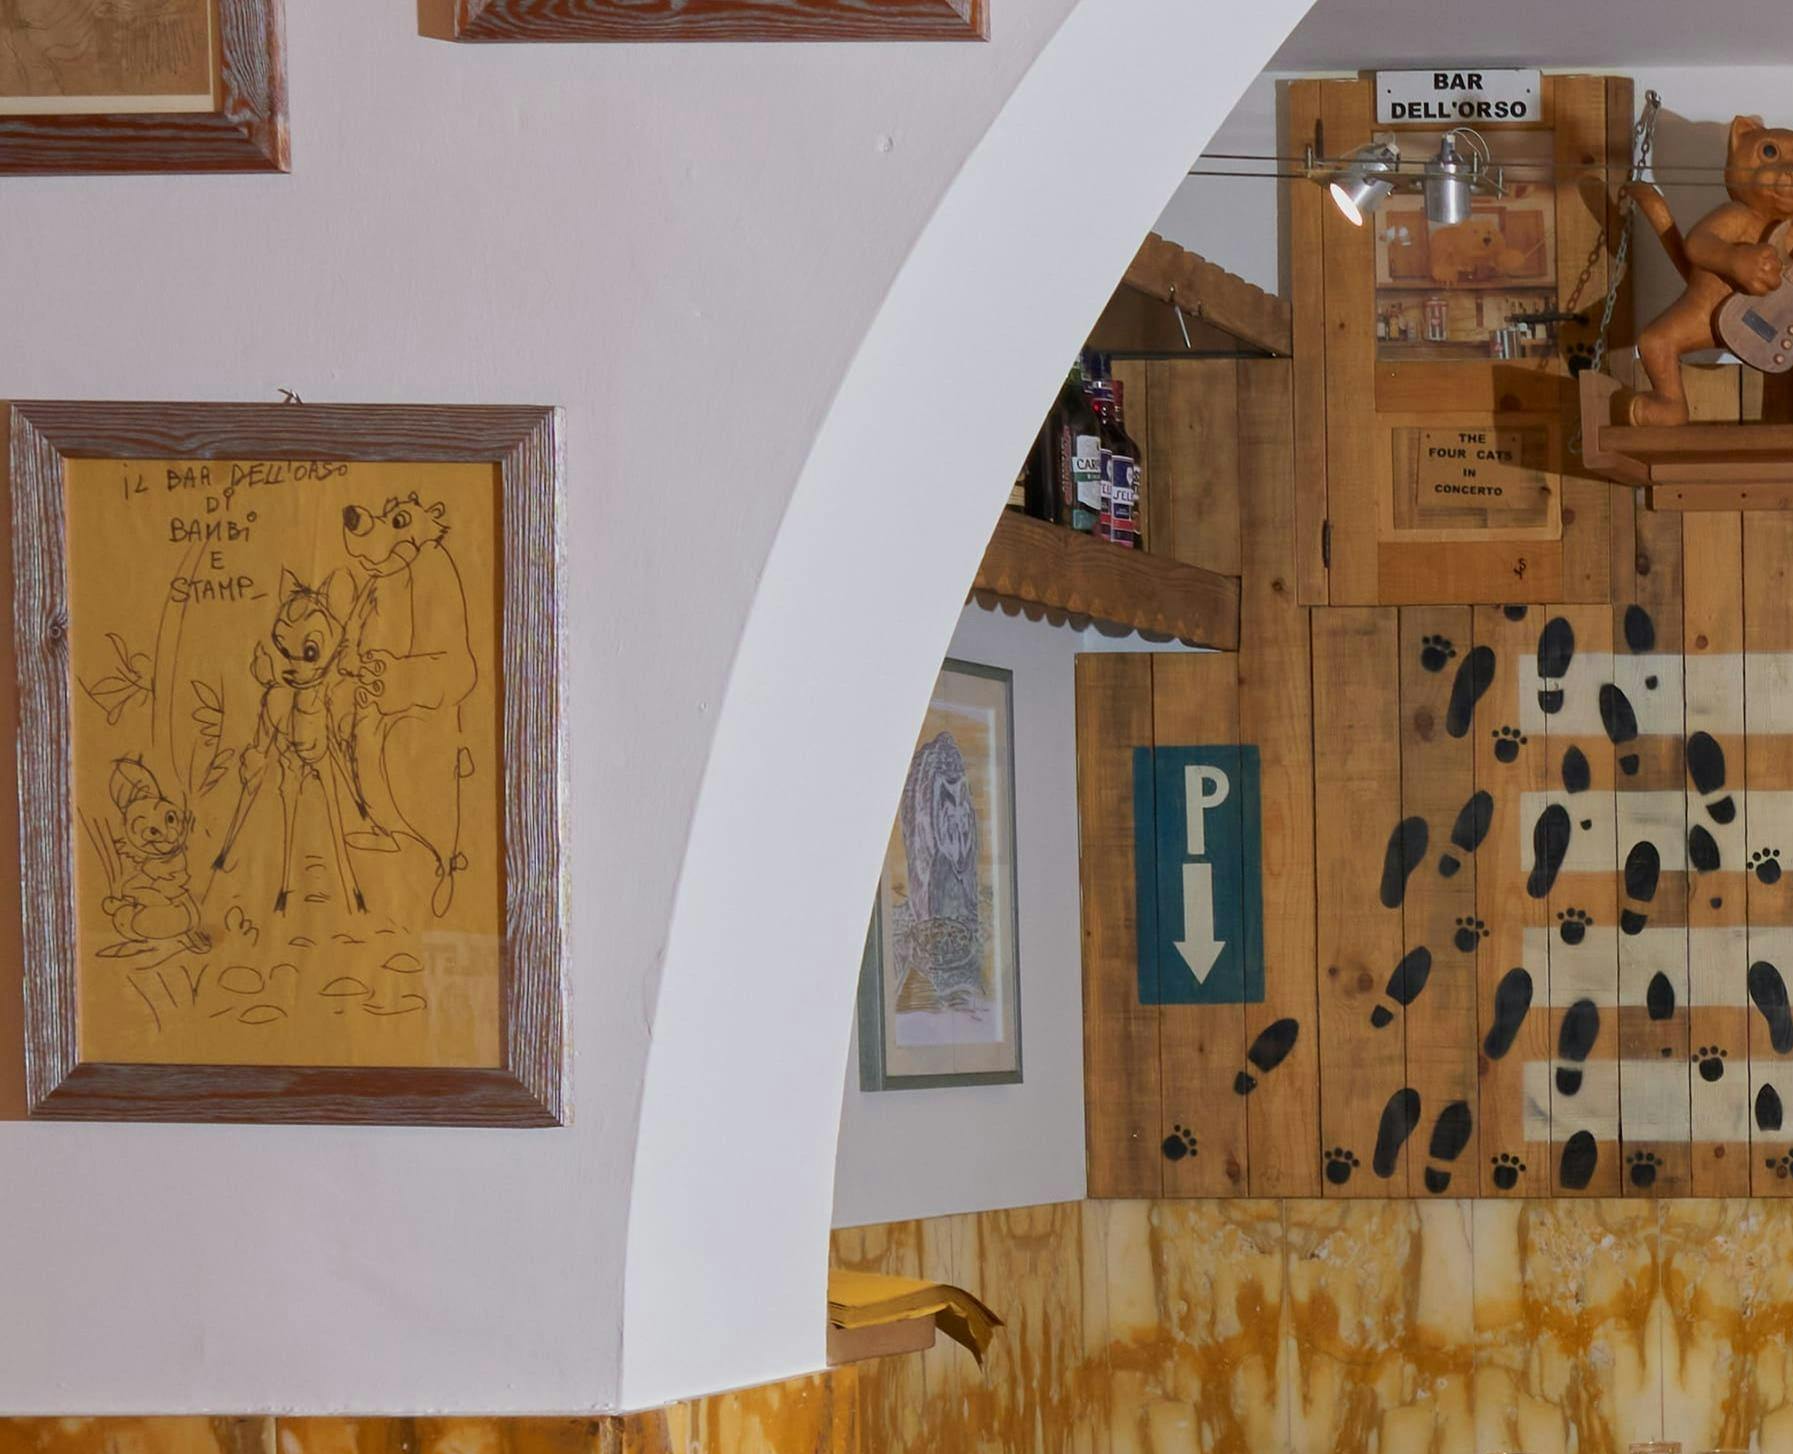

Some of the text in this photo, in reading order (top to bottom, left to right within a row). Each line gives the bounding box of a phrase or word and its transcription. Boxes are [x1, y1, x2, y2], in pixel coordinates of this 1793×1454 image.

[1433, 73, 1483, 90] BAR
[1391, 101, 1527, 119] DELL'ORSO
[1459, 433, 1486, 444] THE
[1428, 447, 1513, 461] FOUR CATS
[1463, 468, 1476, 477] IN
[1434, 484, 1503, 496] CONCERTO
[210, 551, 225, 570] E
[1184, 764, 1231, 855] P
